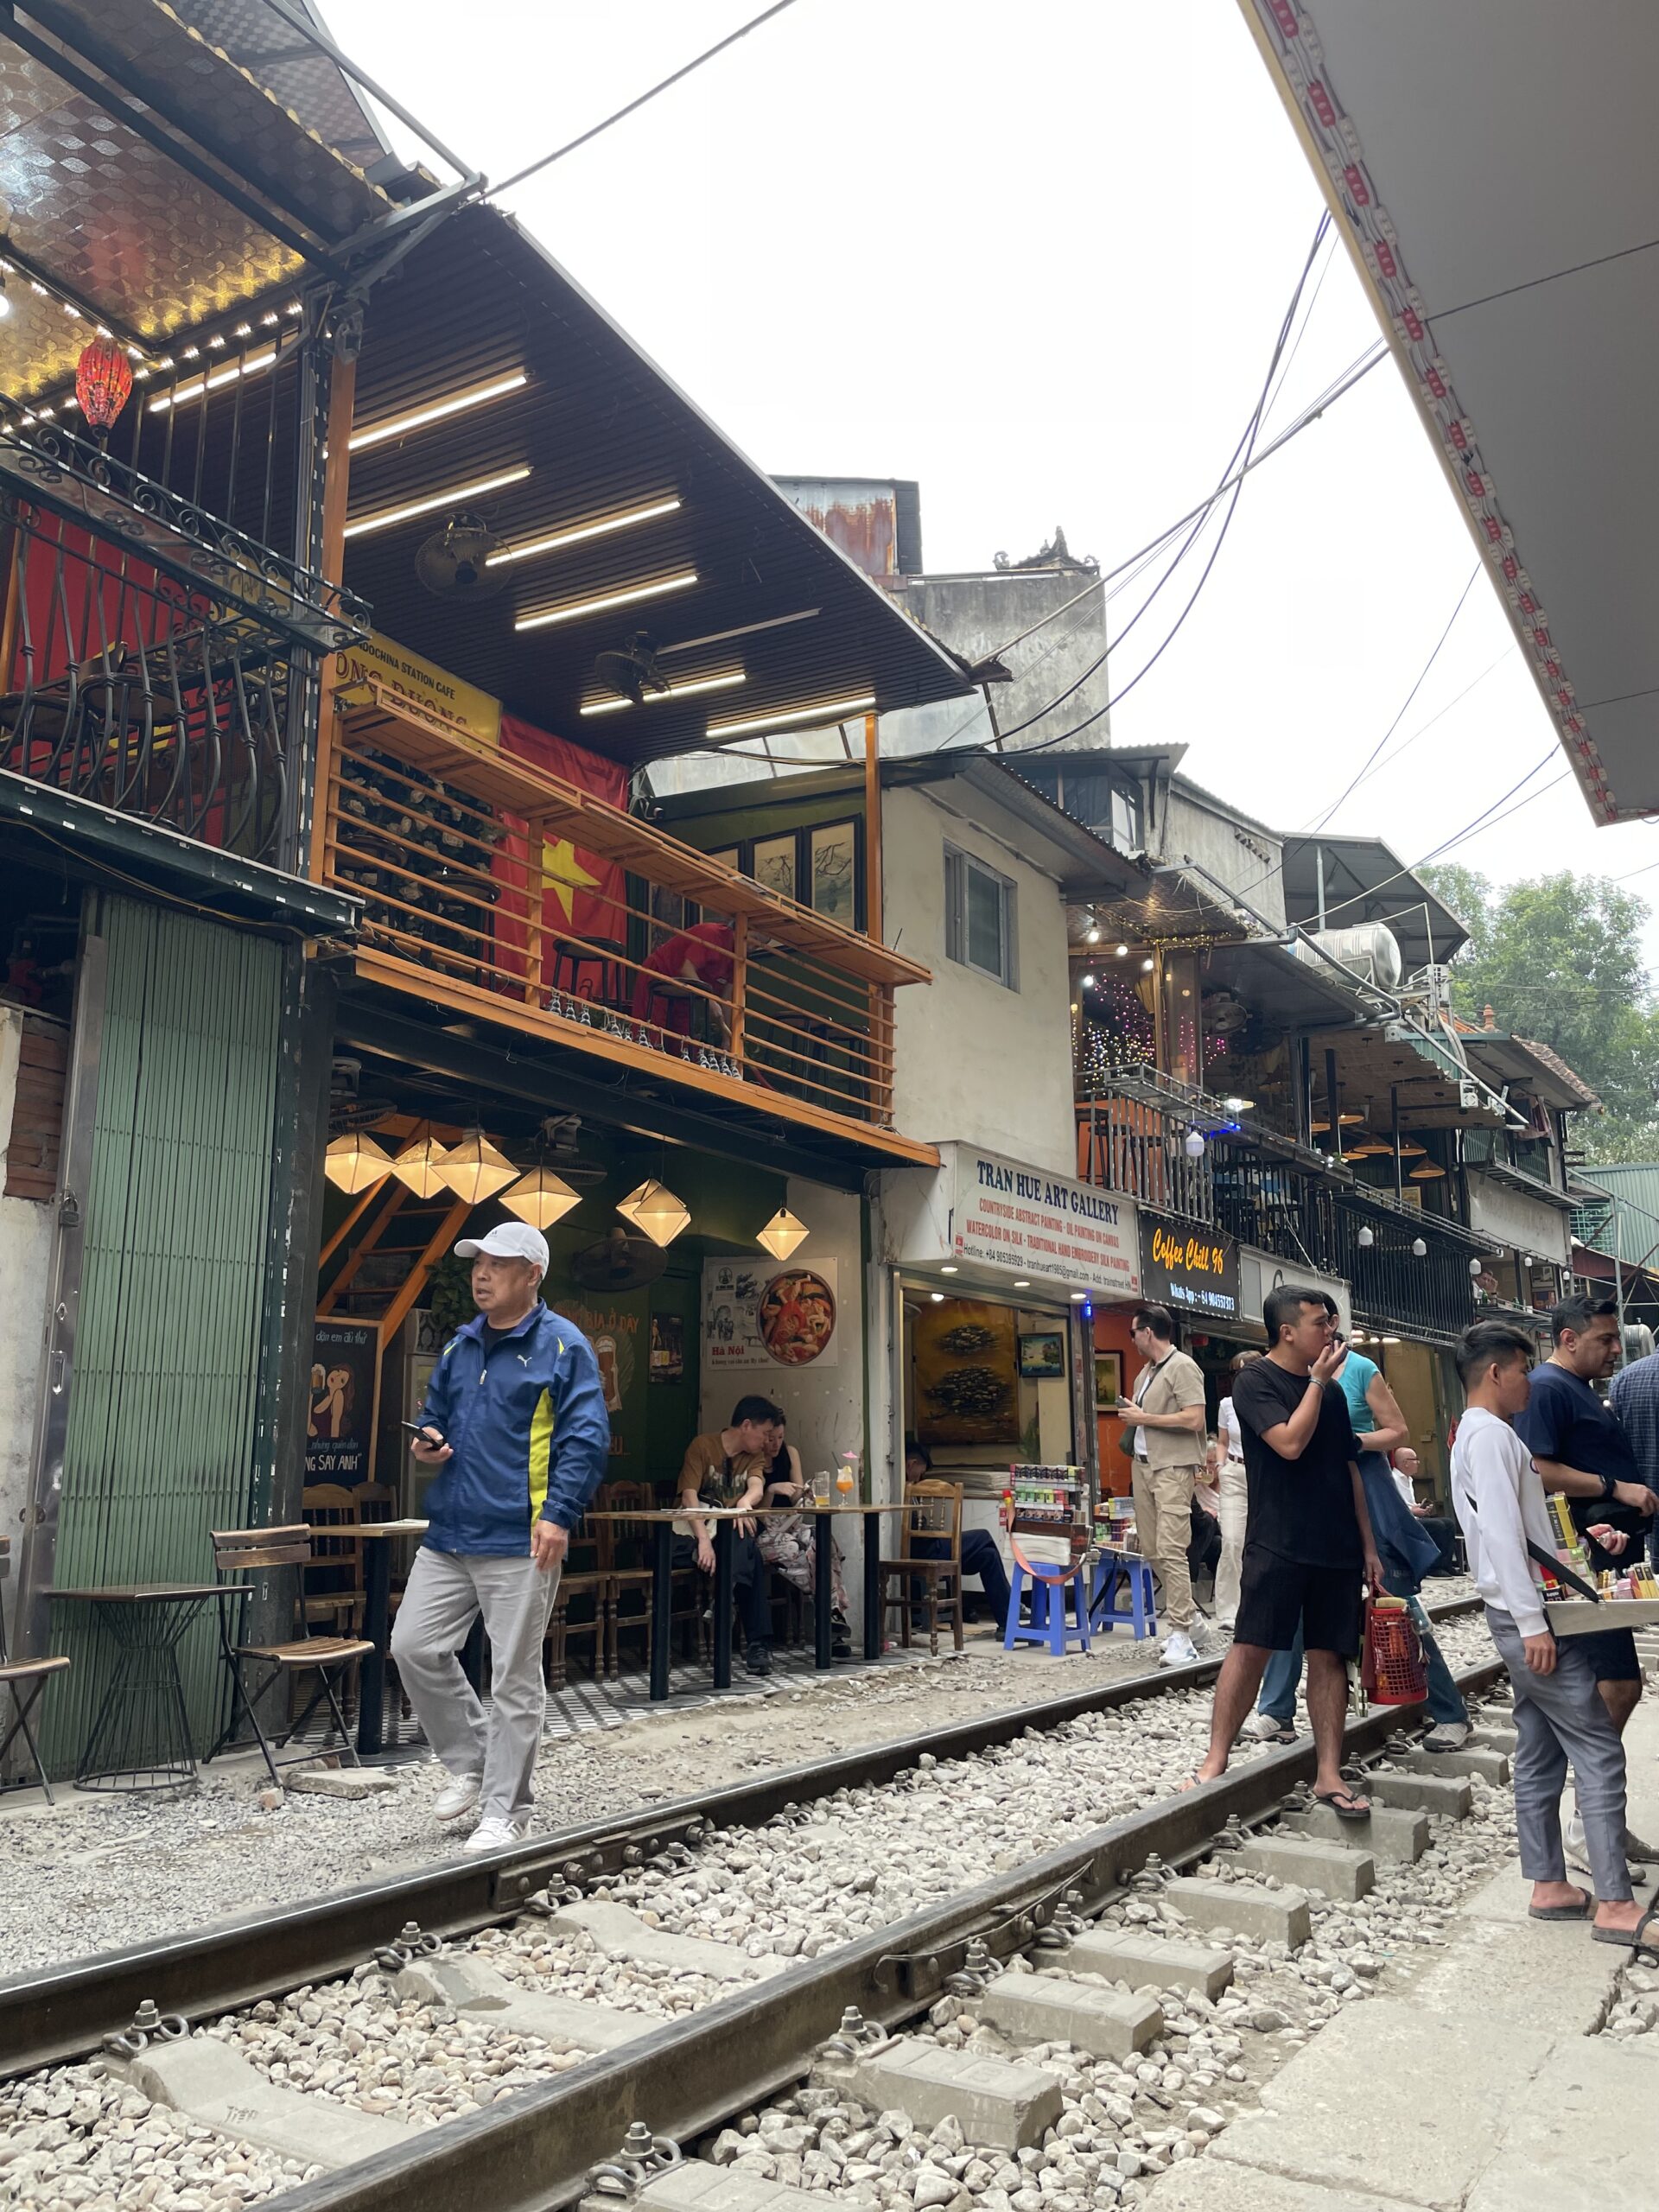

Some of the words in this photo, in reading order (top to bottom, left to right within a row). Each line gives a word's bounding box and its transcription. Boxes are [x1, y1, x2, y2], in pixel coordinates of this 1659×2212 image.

[401, 661, 435, 689] STATION
[435, 681, 456, 700] CAFE
[977, 1160, 1014, 1194] TRAN
[1016, 1173, 1041, 1202] HUE
[1044, 1182, 1068, 1210] ART
[1071, 1191, 1119, 1225] GALLERY
[979, 1198, 1014, 1219] COUNTRYSIDE
[1015, 1208, 1040, 1226] ABSTRACT
[1040, 1214, 1063, 1233] PAINTING
[1075, 1224, 1095, 1242] PAINTING
[1096, 1230, 1103, 1244] ON
[1103, 1232, 1119, 1249] CANVAS
[964, 1243, 984, 1258] Hotline:
[986, 1249, 995, 1261] +84
[966, 1219, 1001, 1240] WATERCOLOR
[1002, 1228, 1010, 1243] ON
[1012, 1230, 1022, 1245] SILK
[1027, 1235, 1057, 1255] TRADITIONAL
[1058, 1243, 1071, 1257] HAND
[1100, 1253, 1109, 1268] SILK
[1110, 1255, 1129, 1272] PAINTING
[1153, 1227, 1183, 1271] Coffee
[1185, 1237, 1210, 1271] Chill
[1211, 1247, 1224, 1274] 96
[1170, 1282, 1185, 1300] Whats
[331, 1333, 342, 1342] em
[318, 1454, 336, 1471] SAY
